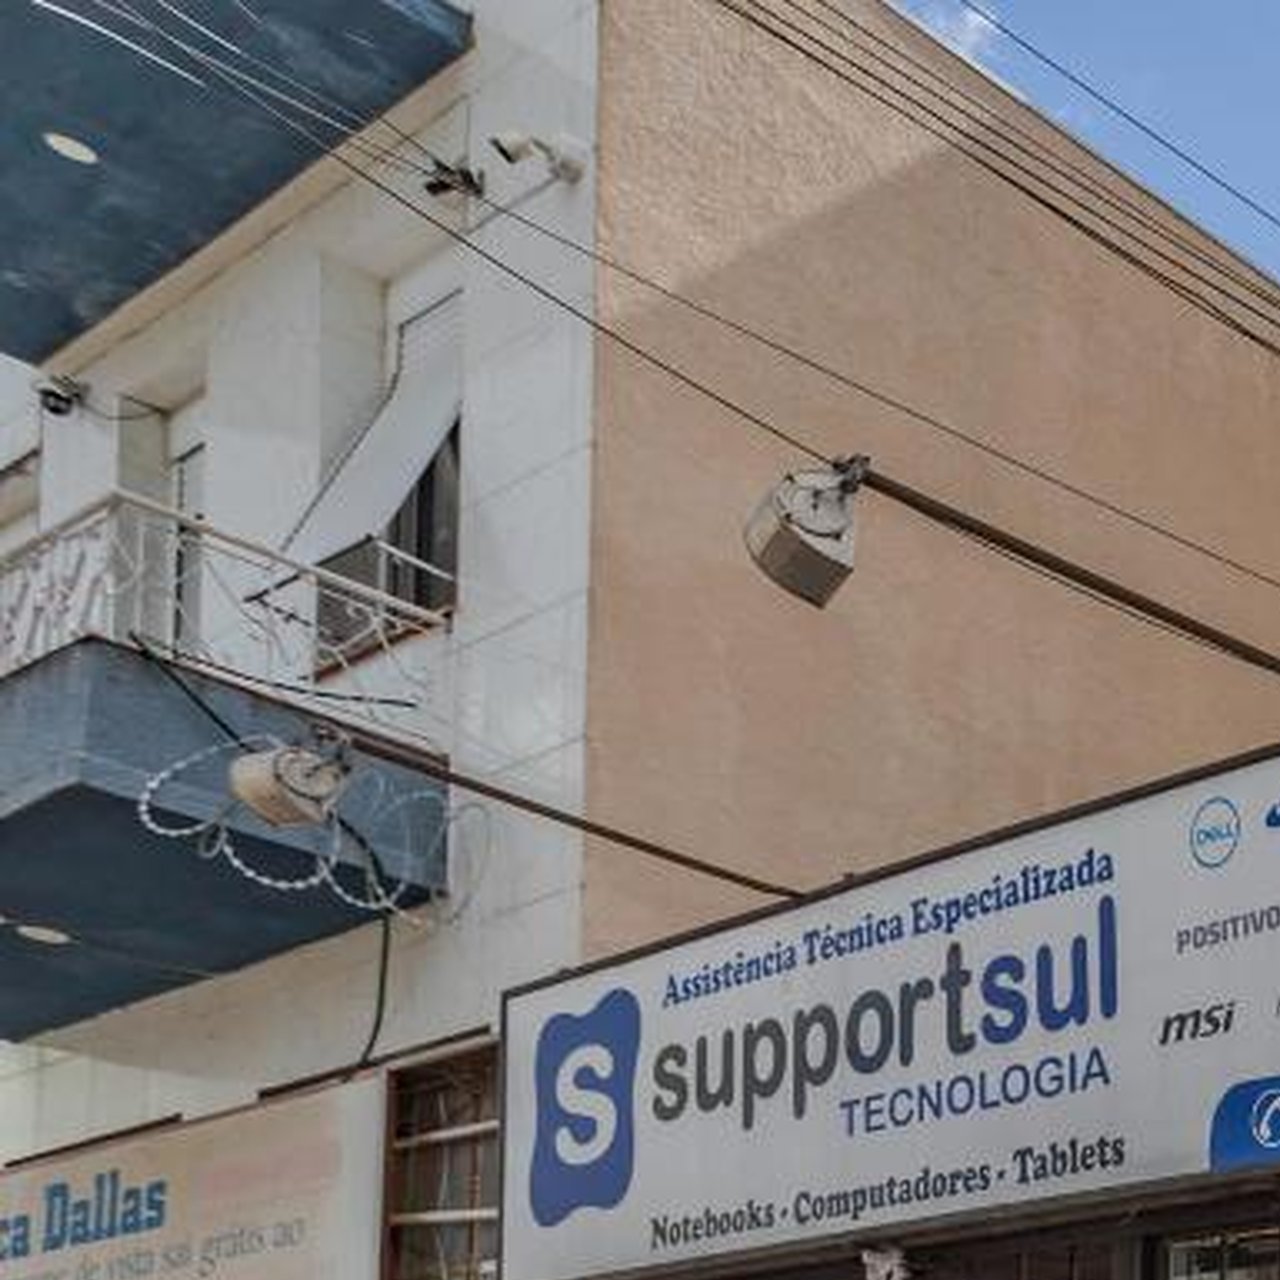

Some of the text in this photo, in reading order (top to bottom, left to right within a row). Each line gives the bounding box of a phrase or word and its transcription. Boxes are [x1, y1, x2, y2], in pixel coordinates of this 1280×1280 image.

[661, 848, 1115, 1007] Assistência Técnica Especializada
[651, 895, 1118, 1130] supportsul
[1158, 1000, 1237, 1046] msi
[840, 1046, 1111, 1136] TECNOLOGIA
[43, 1170, 167, 1252] Dallas
[650, 1132, 1126, 1250] Notebooks Computadores Tablets
